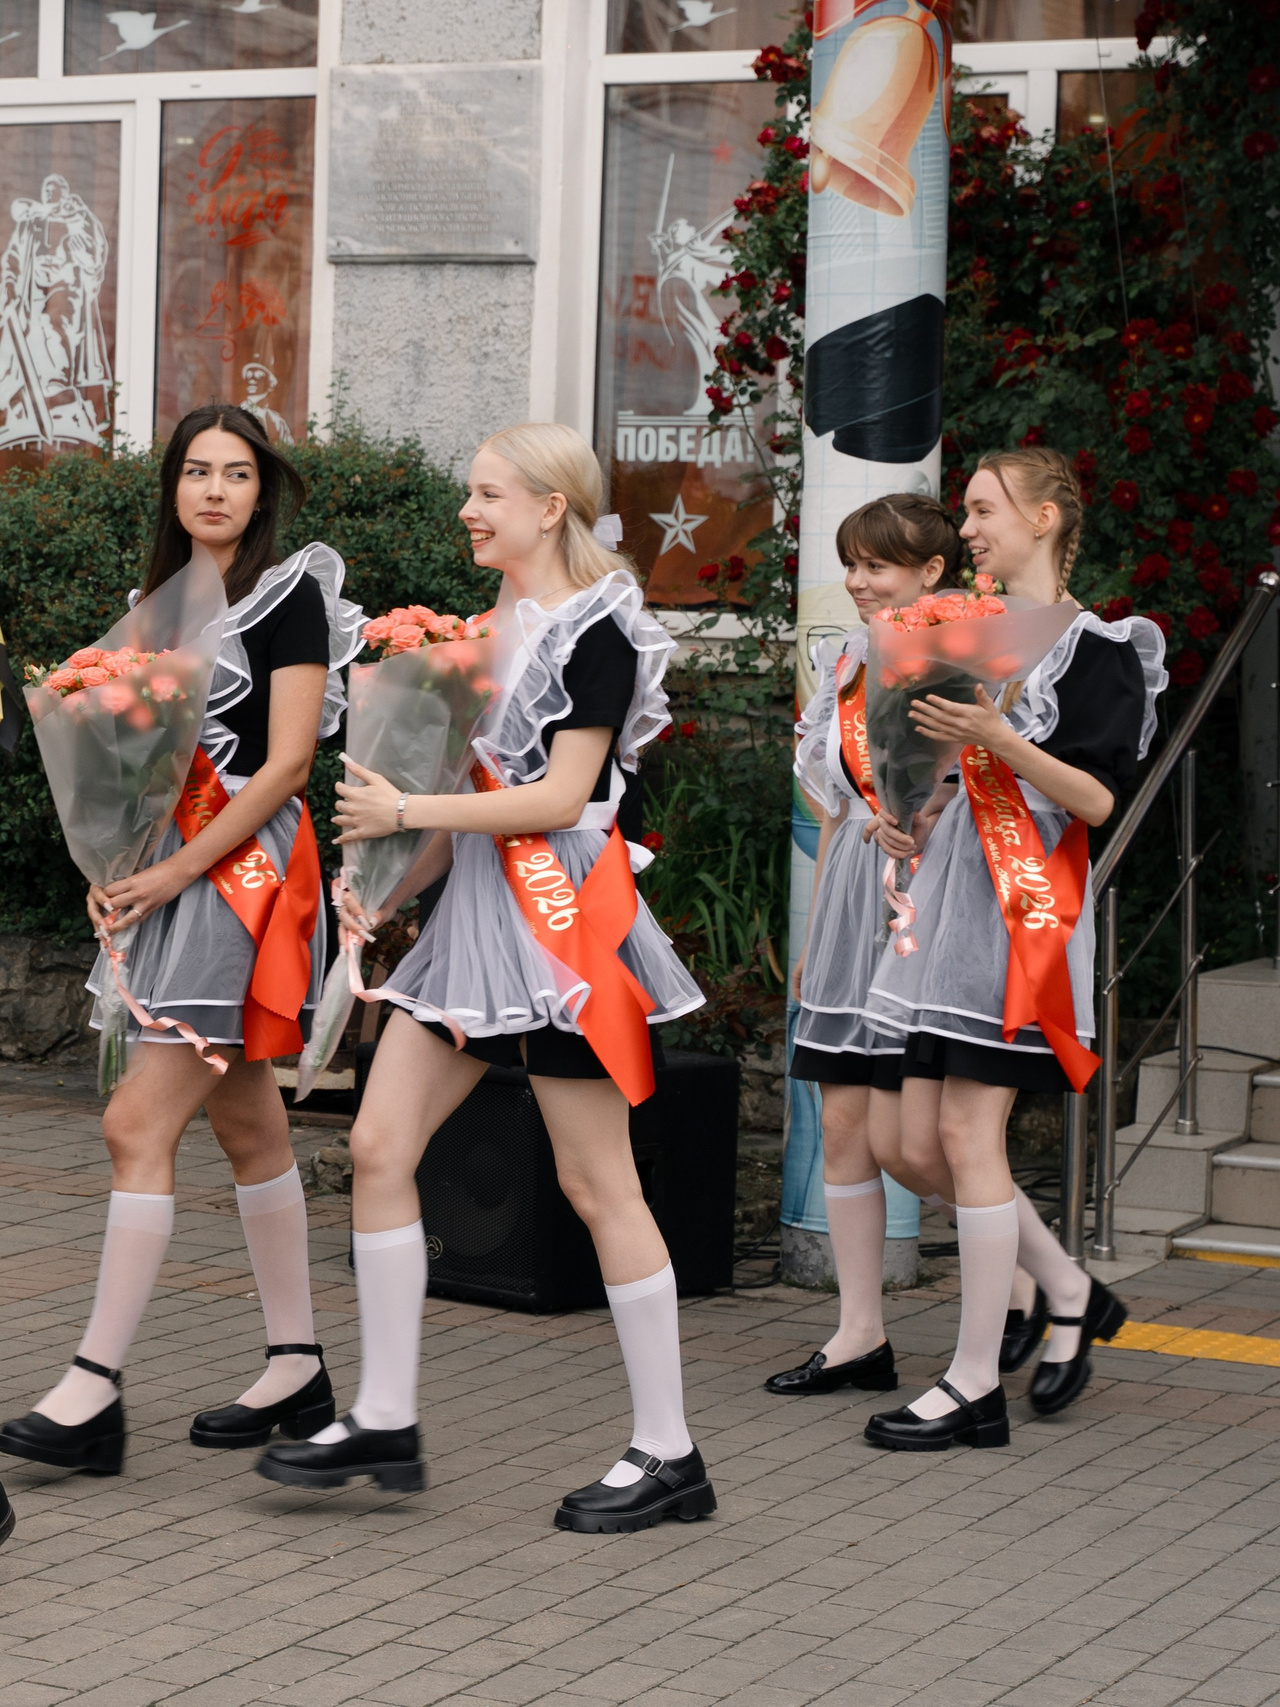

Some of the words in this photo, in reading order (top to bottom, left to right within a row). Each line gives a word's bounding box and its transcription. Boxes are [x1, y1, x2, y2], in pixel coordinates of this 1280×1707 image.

[616, 426, 755, 469] ПОБЕДА!
[512, 851, 580, 931] 2026
[1007, 854, 1060, 930] 2026
